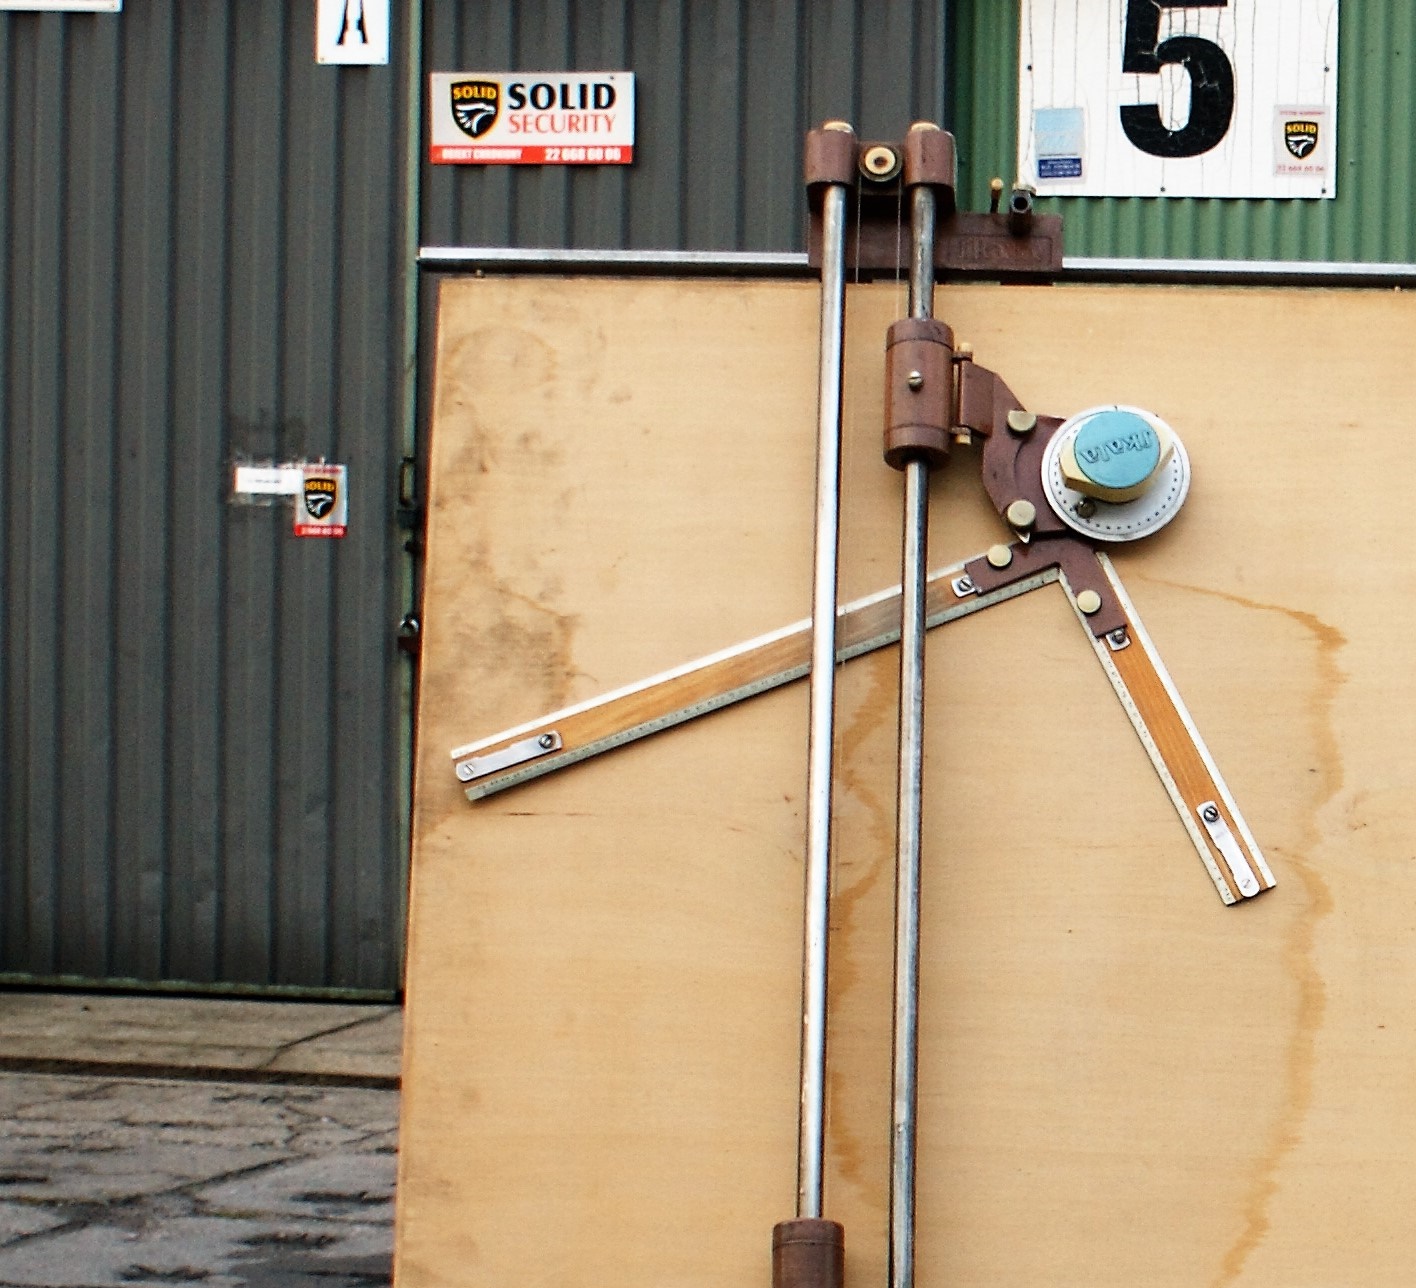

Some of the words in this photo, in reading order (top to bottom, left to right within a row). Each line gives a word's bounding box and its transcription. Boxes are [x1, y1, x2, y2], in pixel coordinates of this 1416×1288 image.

[1120, 0, 1234, 157] 5
[453, 86, 497, 100] SOLID
[507, 82, 616, 110] SOLID
[508, 114, 617, 133] SECURITY
[1286, 123, 1317, 133] SOLID
